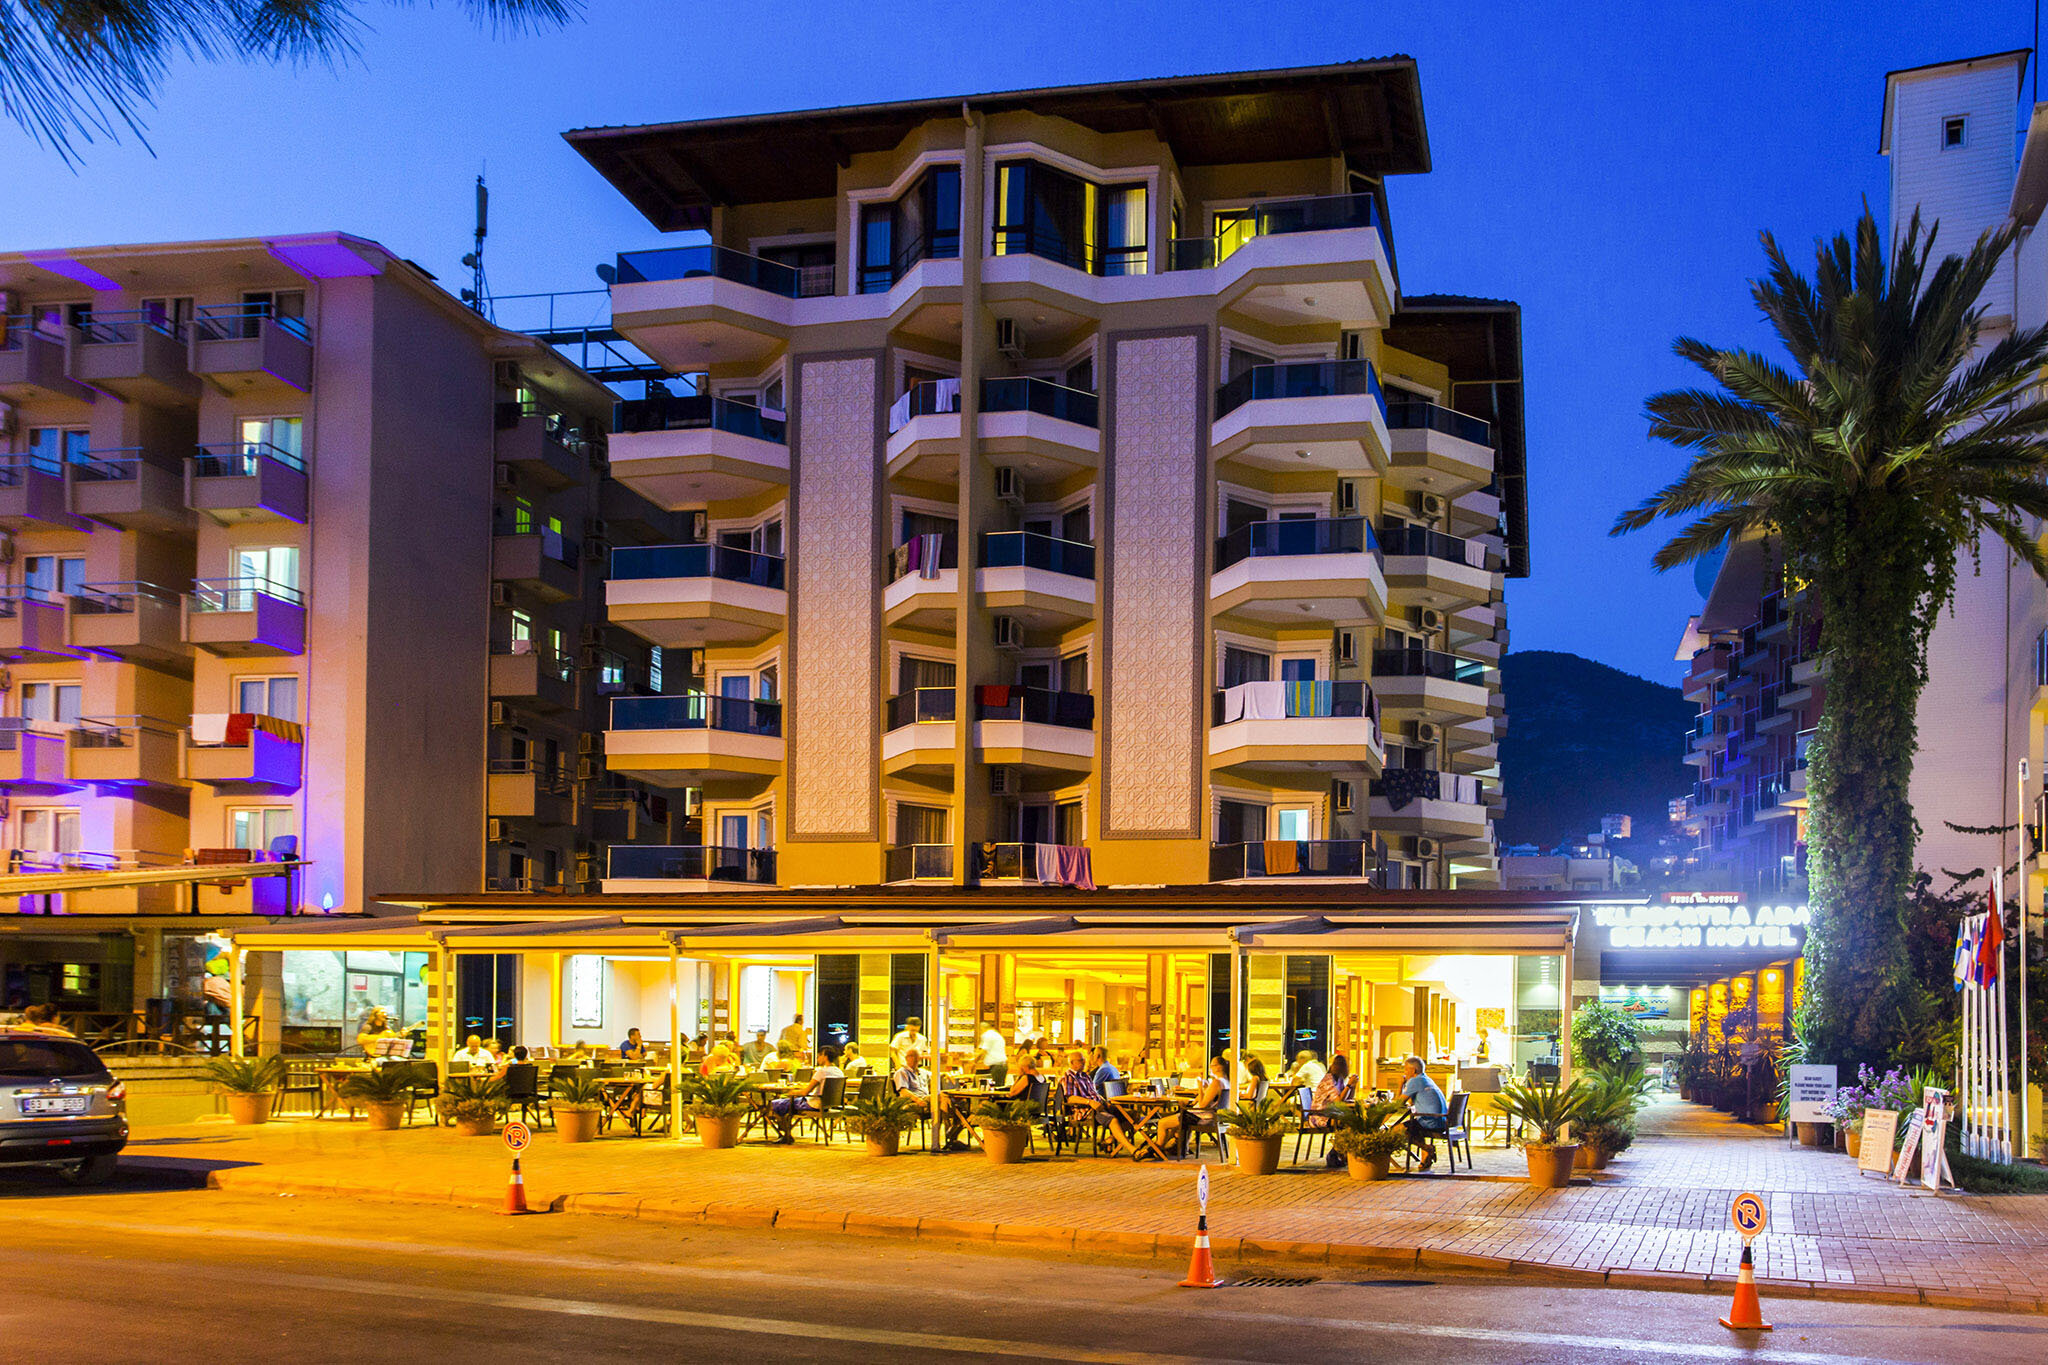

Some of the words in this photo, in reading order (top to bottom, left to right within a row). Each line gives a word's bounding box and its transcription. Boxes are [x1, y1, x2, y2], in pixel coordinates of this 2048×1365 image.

[1595, 906, 1751, 926] KLEOPATRA
[1755, 906, 1811, 926] ADA
[1610, 927, 1700, 947] BEACH
[1706, 927, 1797, 947] HOTEL
